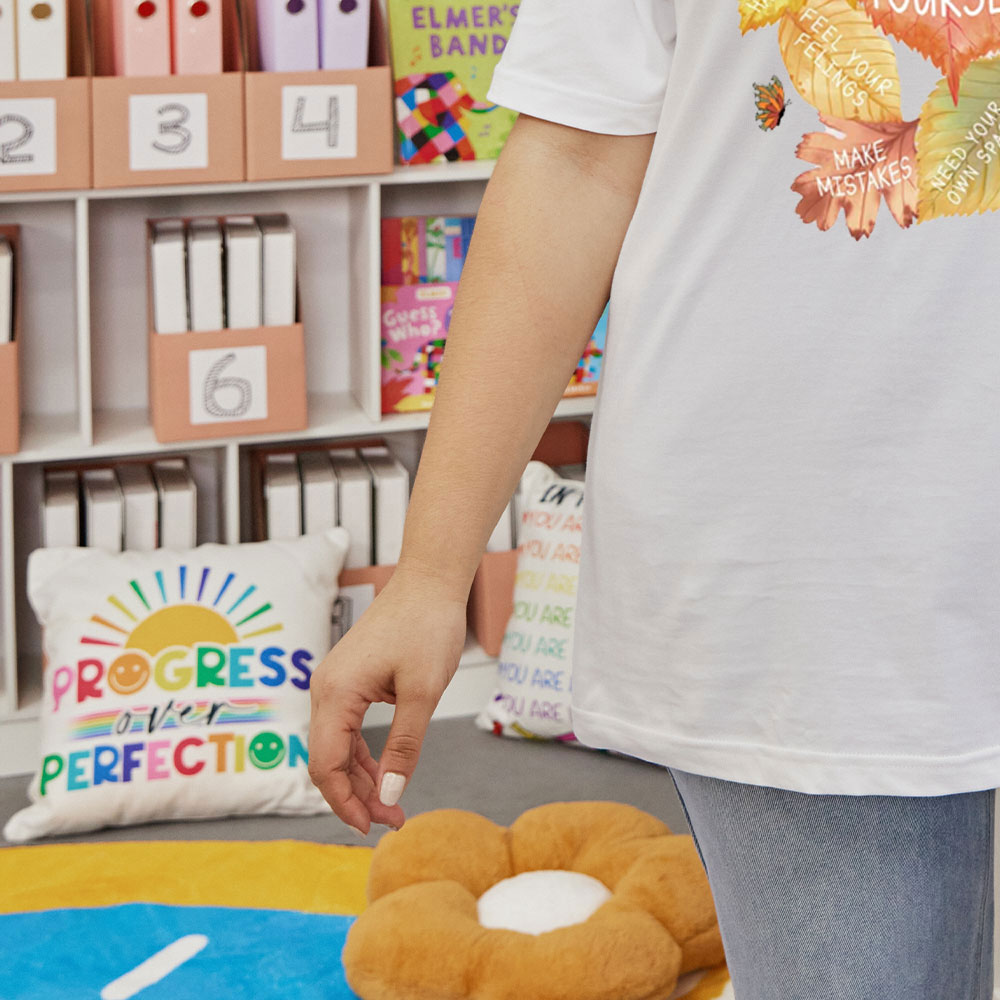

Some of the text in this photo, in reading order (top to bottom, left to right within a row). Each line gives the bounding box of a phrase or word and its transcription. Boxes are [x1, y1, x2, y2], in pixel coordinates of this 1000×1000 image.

[411, 4, 519, 30] ELMER'S
[430, 34, 507, 59] BAND
[799, 7, 894, 96] FEEL YOUR
[0, 114, 34, 164] 2
[151, 103, 192, 154] 3
[291, 95, 339, 149] 4
[833, 138, 887, 171] MAKE
[930, 146, 968, 192] NEED
[815, 155, 913, 198] MISTAKES
[946, 164, 980, 206] OWN
[383, 306, 437, 328] Guess
[387, 319, 443, 343] Who?
[204, 353, 252, 418] 6
[546, 572, 579, 597] ARE
[541, 605, 573, 629] ARE
[537, 635, 568, 660] ARE
[52, 646, 313, 713] PROGRESS
[531, 666, 563, 692] ARE
[115, 698, 258, 735] over
[530, 697, 561, 722] ARE
[39, 730, 309, 797] PERFECTION
